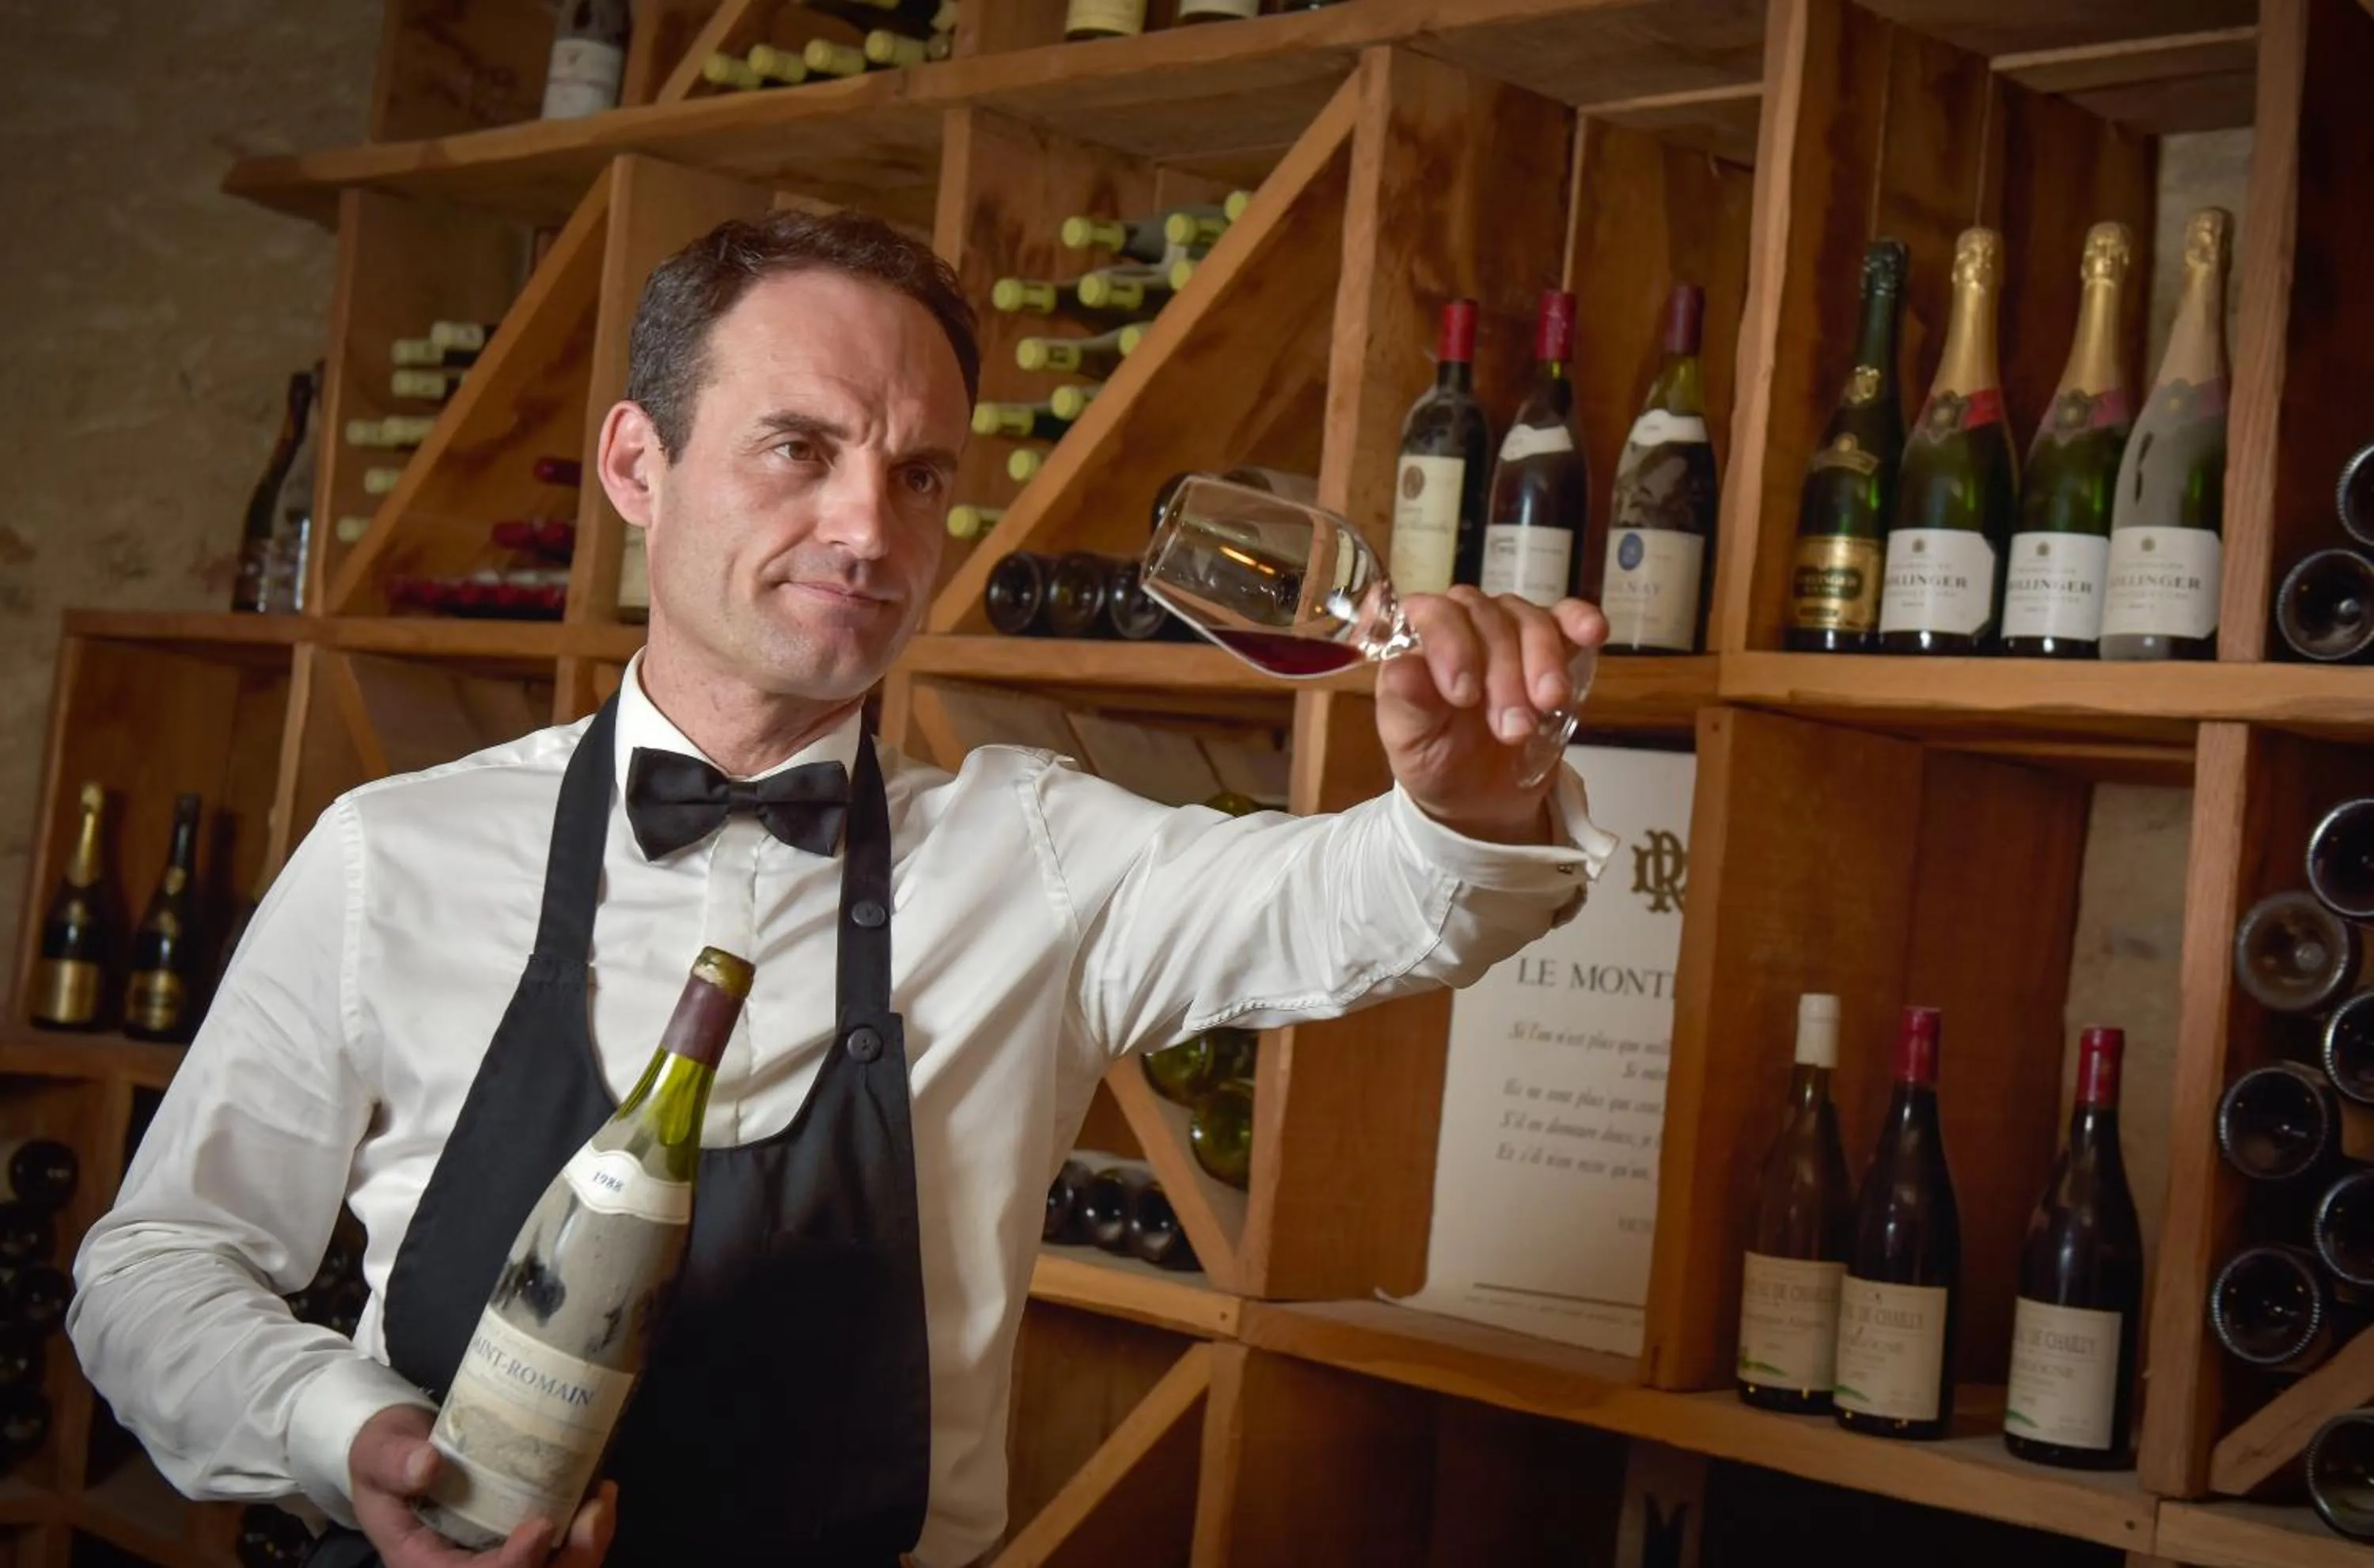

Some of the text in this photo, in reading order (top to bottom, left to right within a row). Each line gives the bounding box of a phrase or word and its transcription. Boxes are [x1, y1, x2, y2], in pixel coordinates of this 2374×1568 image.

[1517, 956, 1674, 1001] LE MONT
[592, 1171, 624, 1193] 1988
[473, 1335, 594, 1407] AINT-ROMAIN
